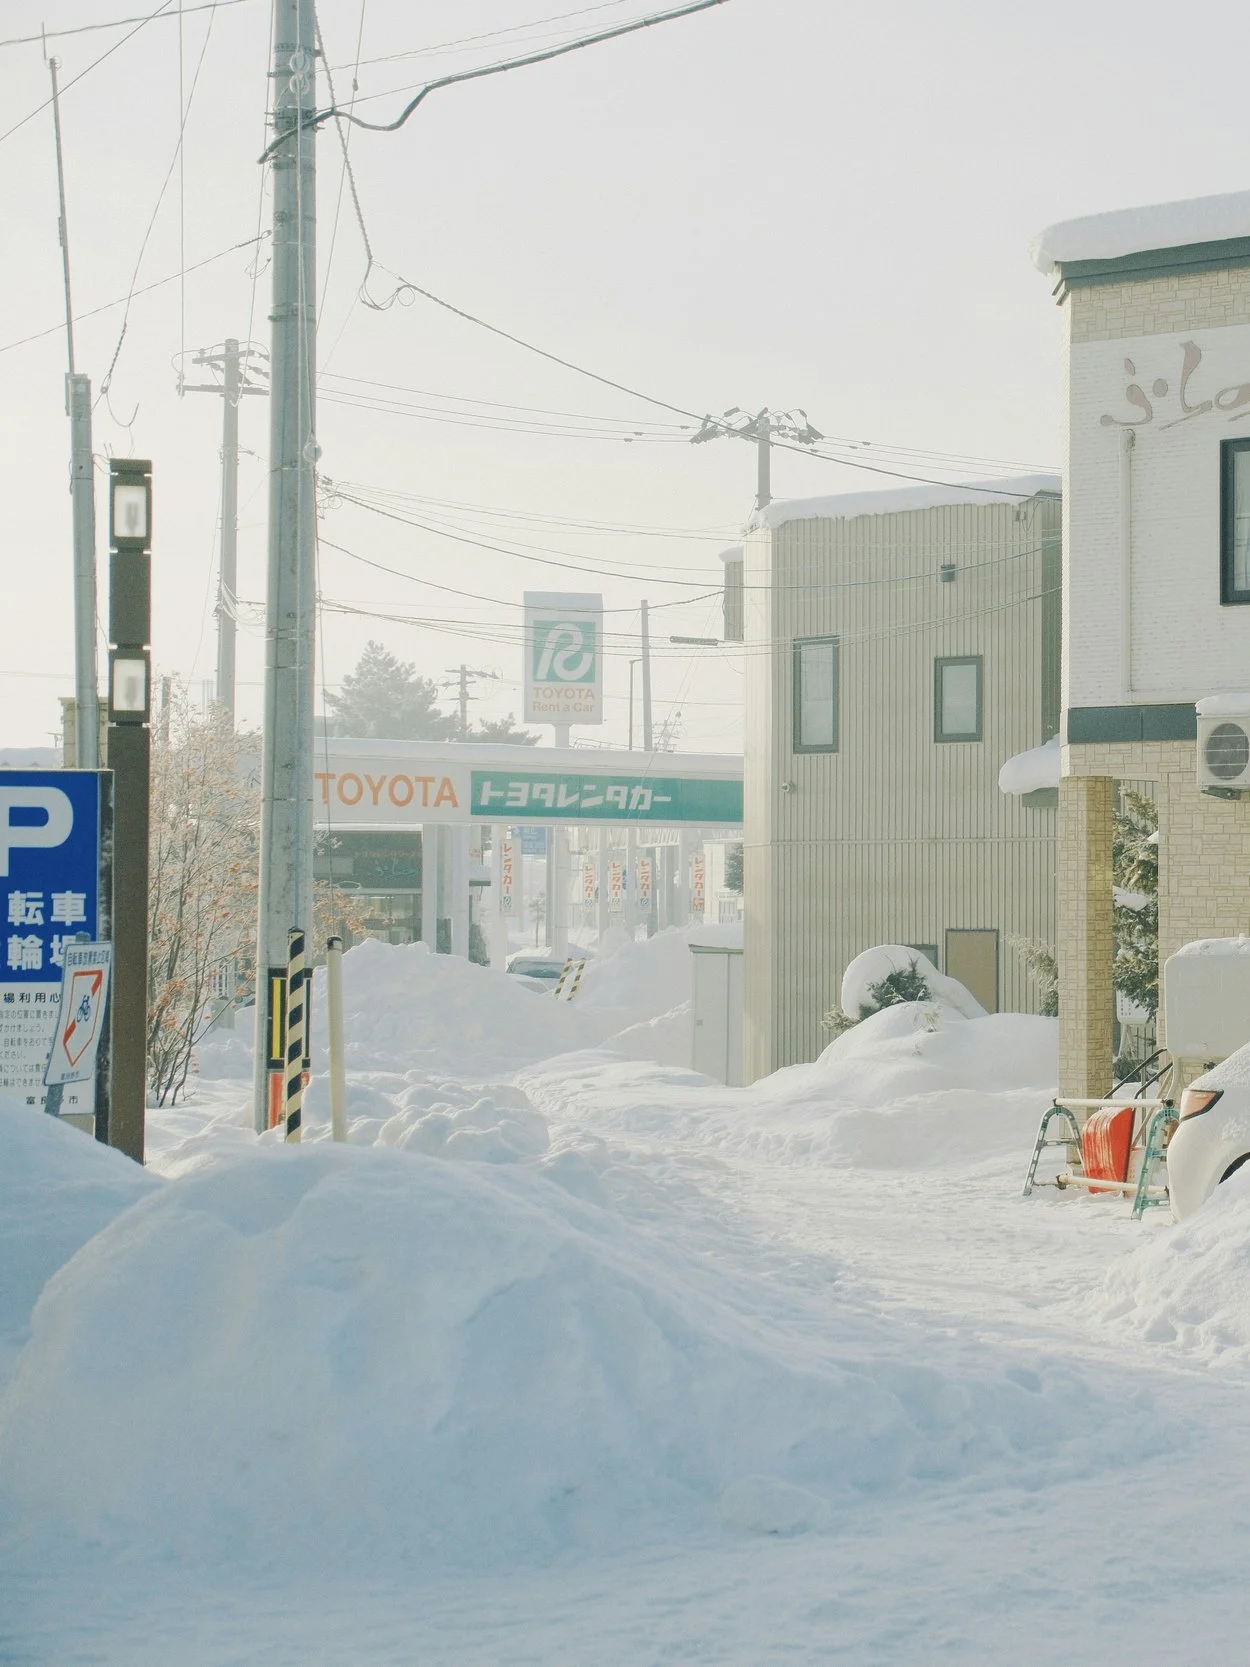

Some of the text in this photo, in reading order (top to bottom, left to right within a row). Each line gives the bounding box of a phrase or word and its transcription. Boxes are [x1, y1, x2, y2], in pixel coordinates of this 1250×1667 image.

[533, 687, 595, 700] TOYOTA
[533, 701, 595, 712] Rent a Car
[314, 772, 459, 808] TOYOTA
[480, 780, 671, 811] トヨタレンタカー
[0, 786, 74, 877] P
